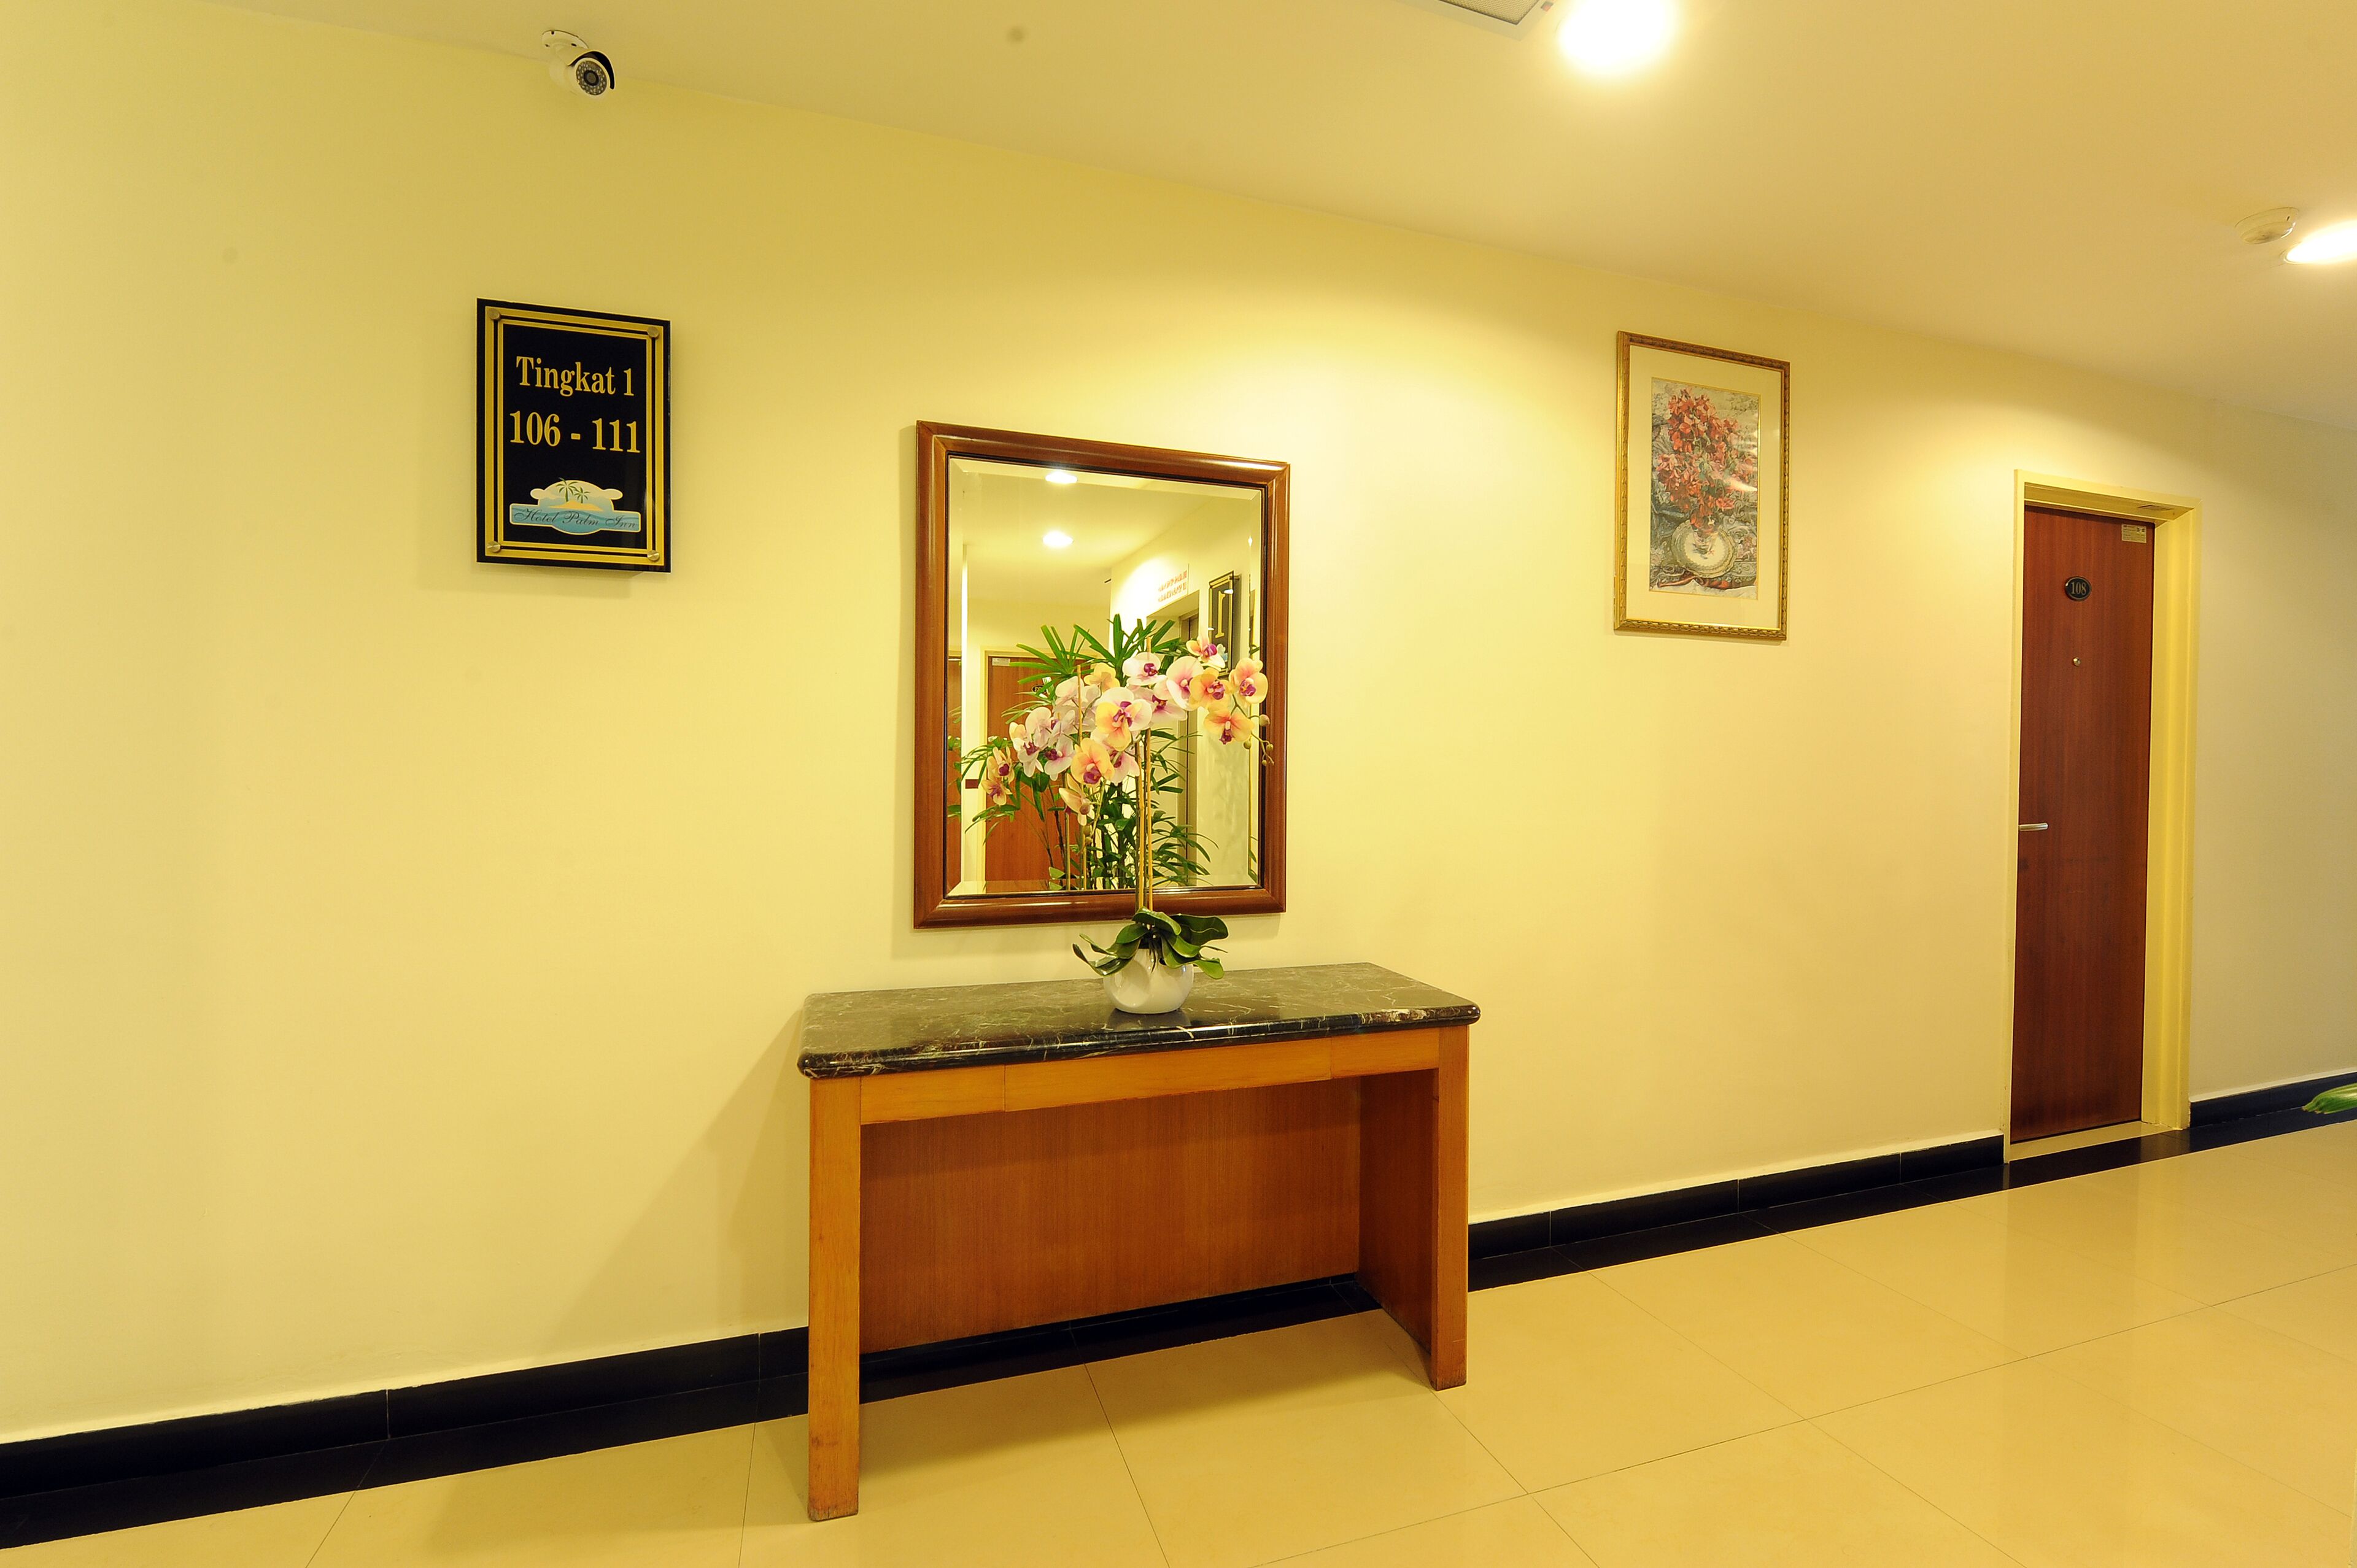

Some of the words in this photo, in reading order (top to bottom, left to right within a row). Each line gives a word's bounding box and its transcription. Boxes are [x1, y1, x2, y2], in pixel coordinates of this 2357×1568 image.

[516, 355, 616, 396] Tingkat
[623, 368, 634, 396] 1
[509, 410, 561, 447] 106
[591, 418, 641, 454] 111
[514, 508, 560, 522] Hotel
[562, 511, 600, 526] Palm
[605, 515, 637, 528] Inn
[2070, 582, 2087, 595] 108
